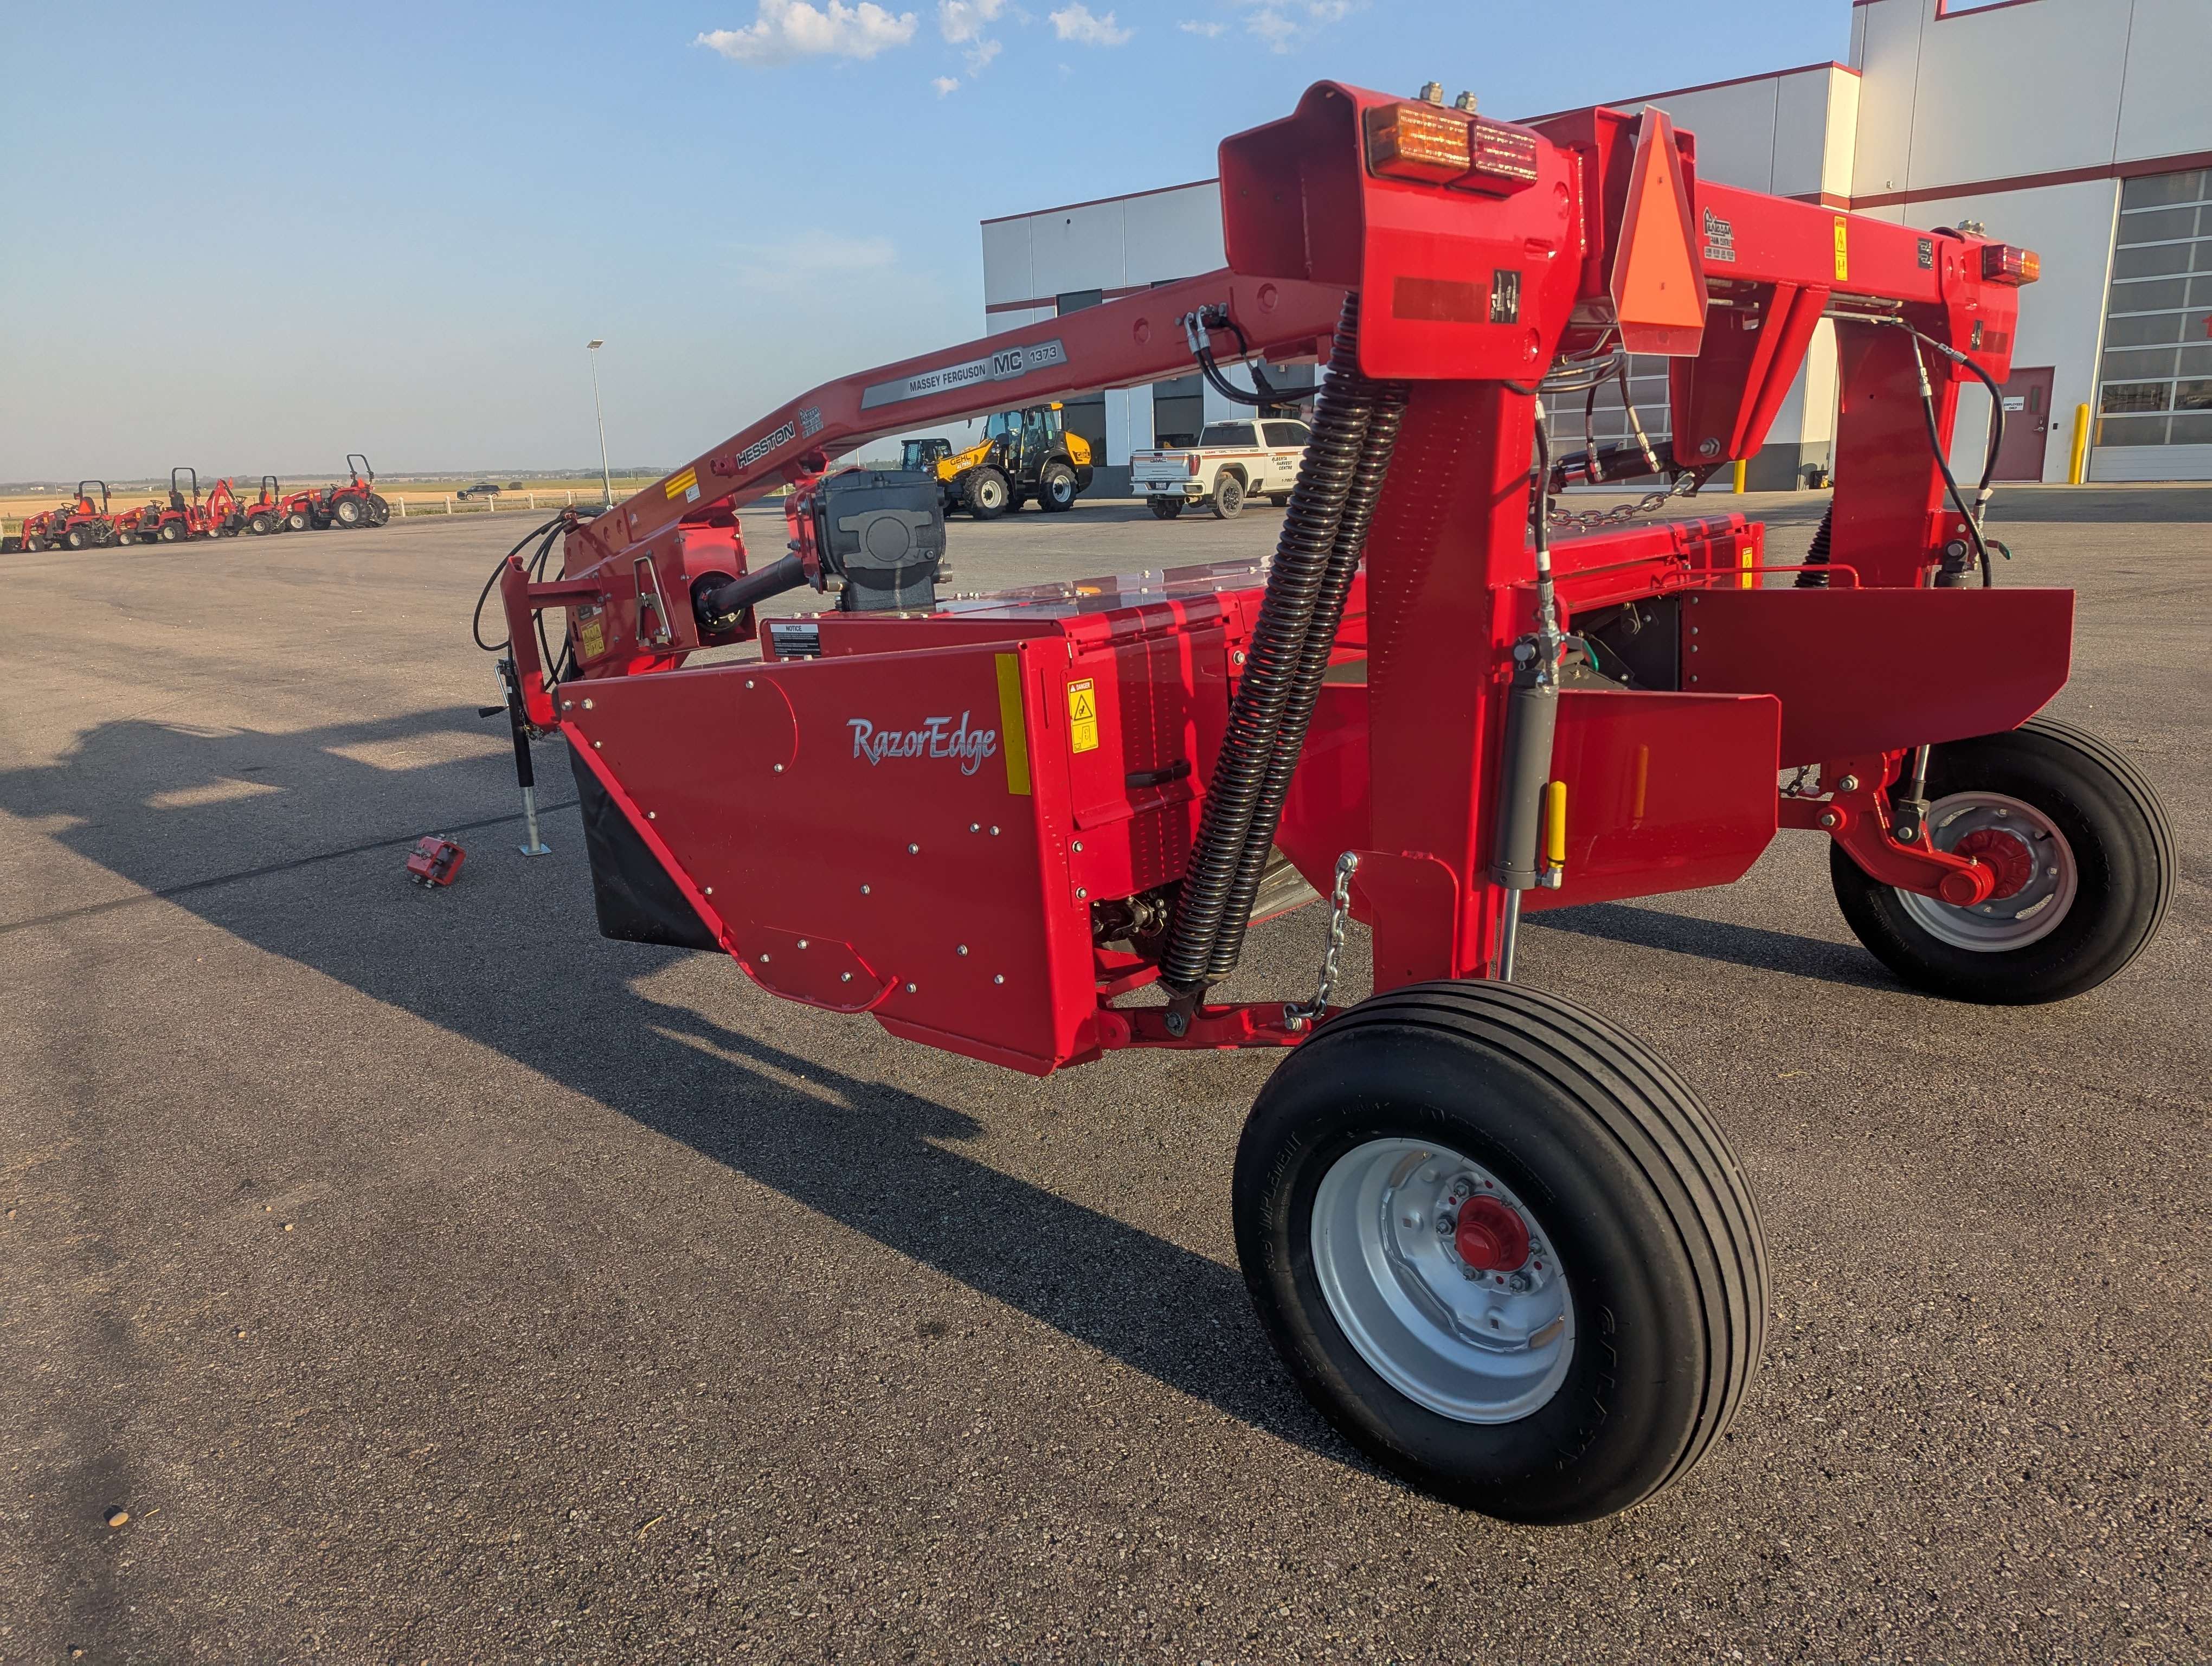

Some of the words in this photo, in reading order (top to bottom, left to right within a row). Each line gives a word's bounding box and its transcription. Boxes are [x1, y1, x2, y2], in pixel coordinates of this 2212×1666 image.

[909, 375, 941, 393] MASSEY
[942, 363, 986, 385] FERGUSON
[993, 350, 1023, 375] MC
[1030, 345, 1057, 362] 1373
[736, 421, 795, 469] HESSTON
[950, 454, 972, 466] GEHL
[1076, 682, 1091, 690] DANGER
[846, 710, 996, 776] RazorEdge
